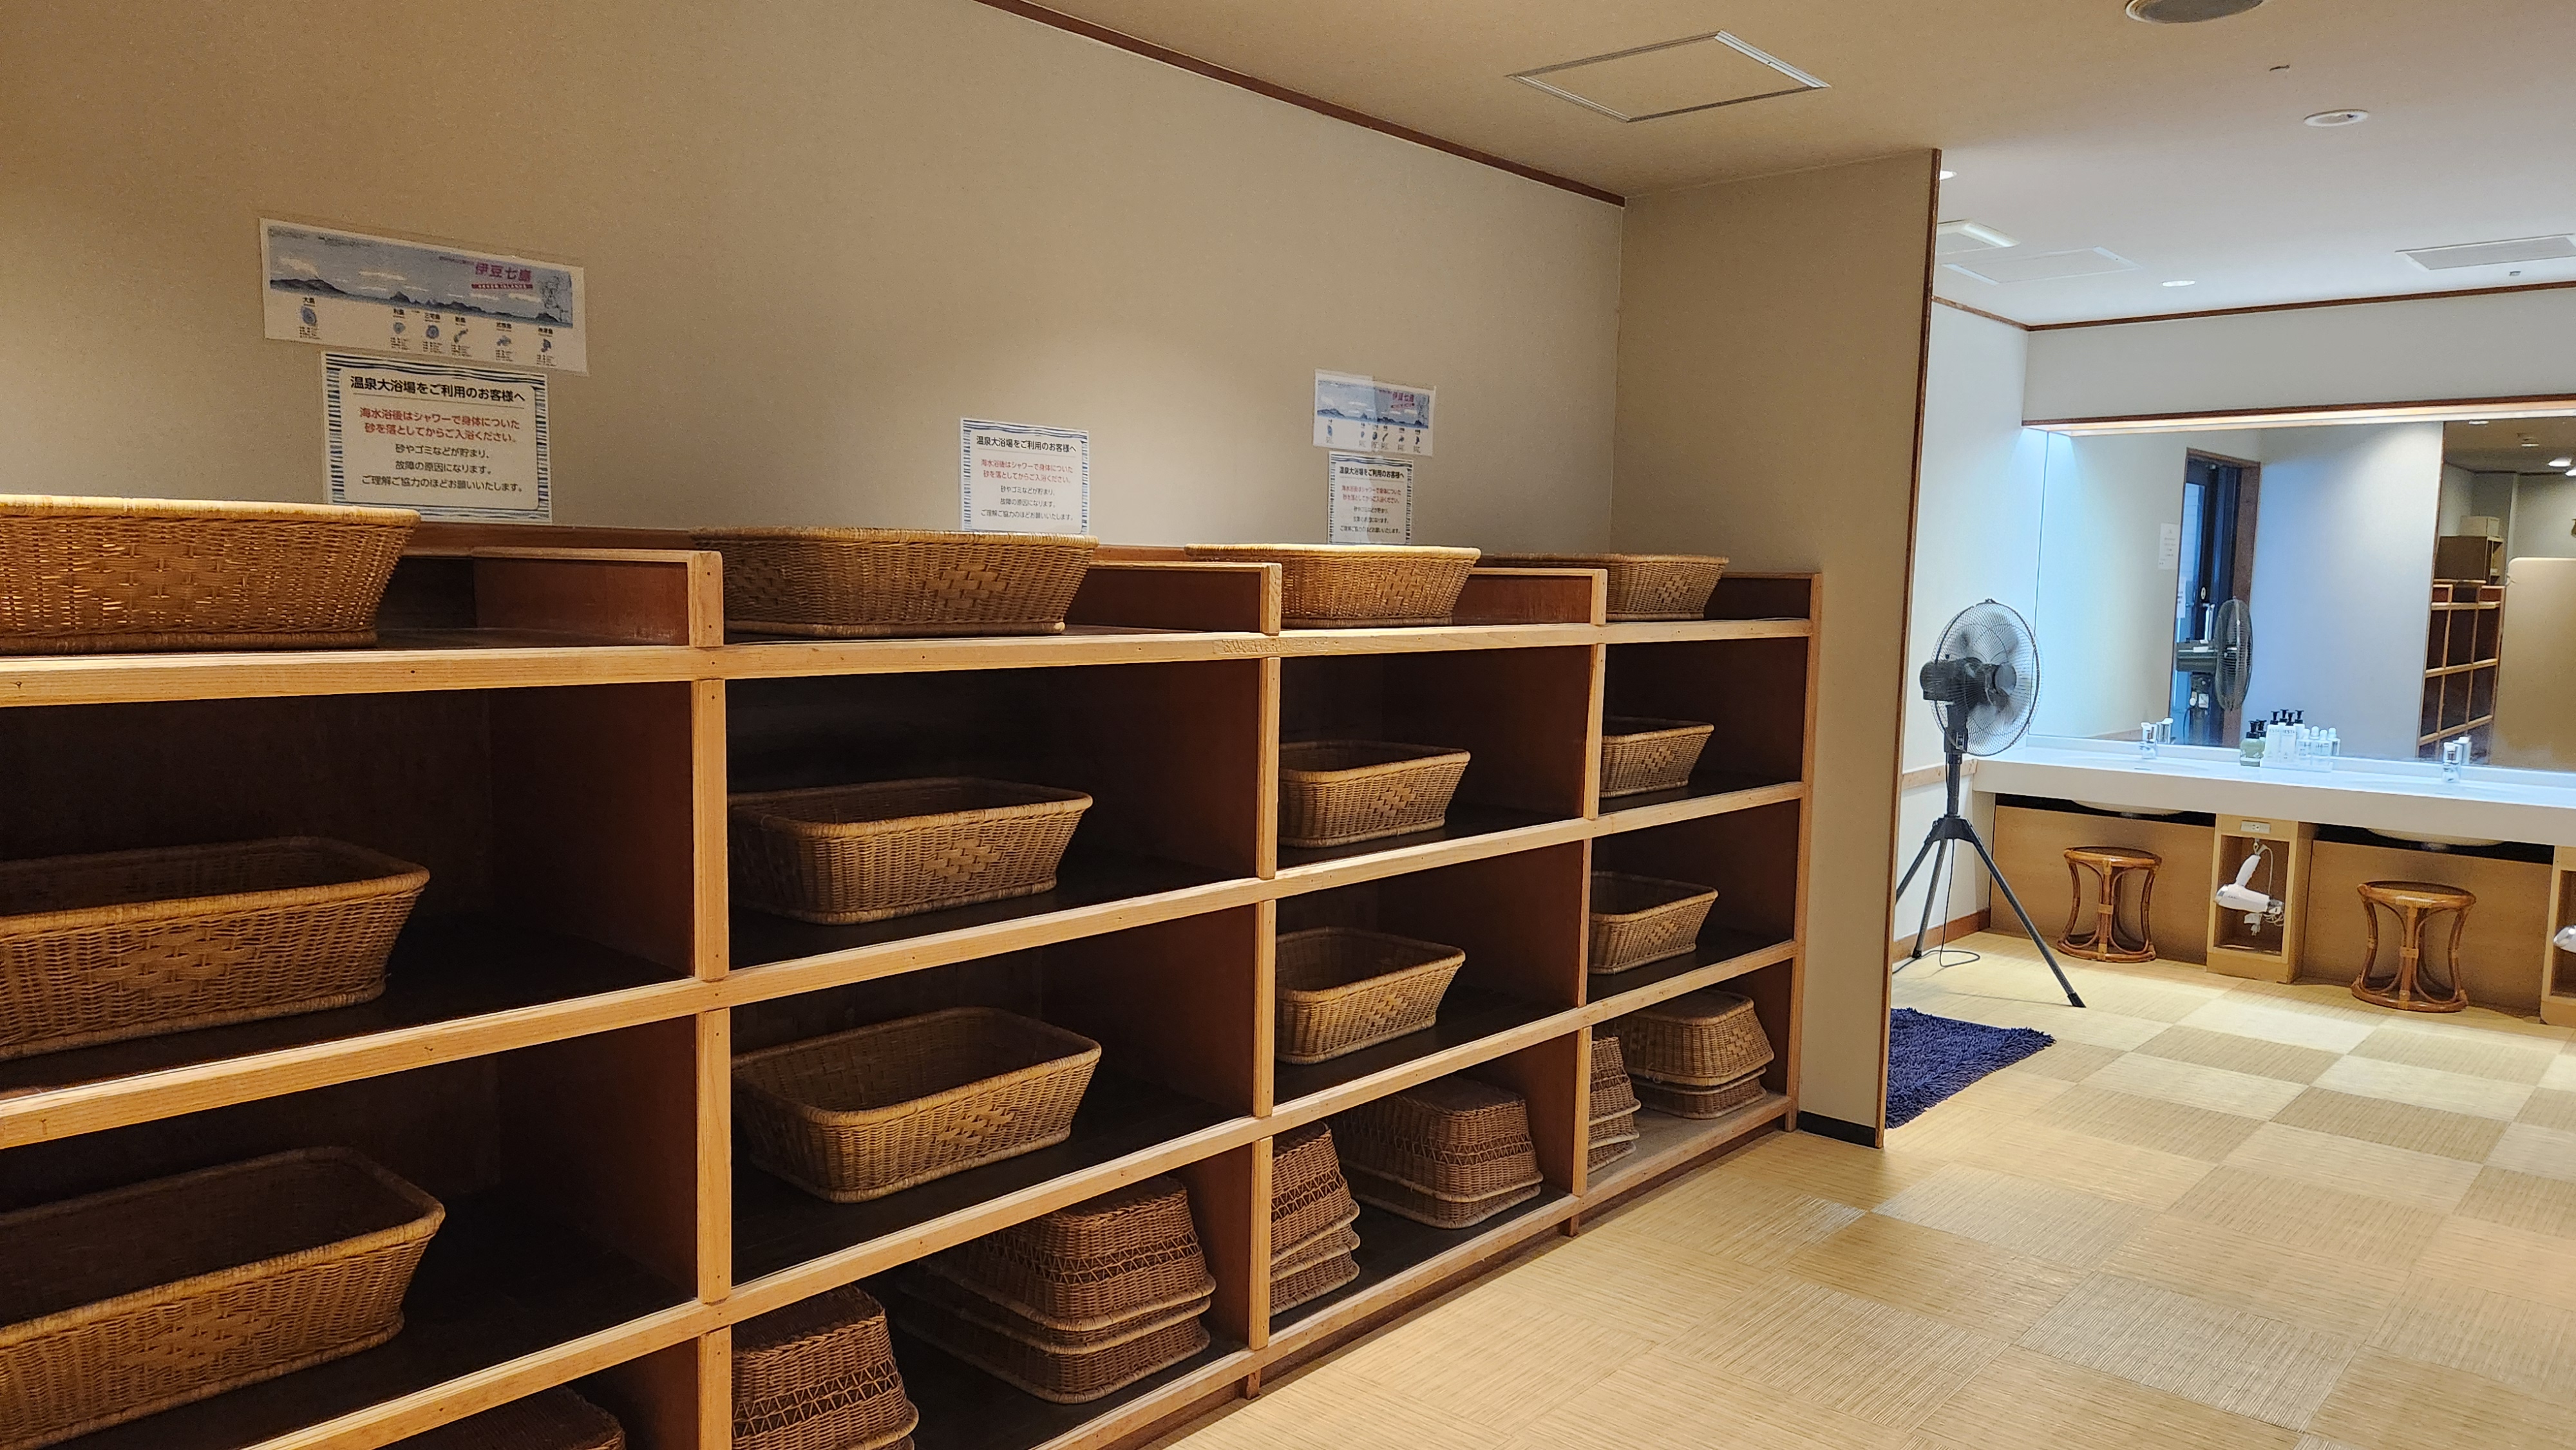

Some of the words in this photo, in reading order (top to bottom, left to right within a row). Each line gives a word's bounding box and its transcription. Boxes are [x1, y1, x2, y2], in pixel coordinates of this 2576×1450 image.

[475, 261, 531, 281] 伊豆七島
[350, 375, 526, 402] 温泉大浴場をご利用のお客様へ
[359, 406, 520, 429] 海水浴後はシャワーで身体についた
[365, 422, 517, 443] 砂を落としてからご入浴ください。
[976, 435, 1077, 453] 温泉大浴場をご利用のお客様へ
[395, 460, 491, 475] 故障の原因になります。
[361, 475, 522, 493] ご理解ご協力のほどお願いいたします。
